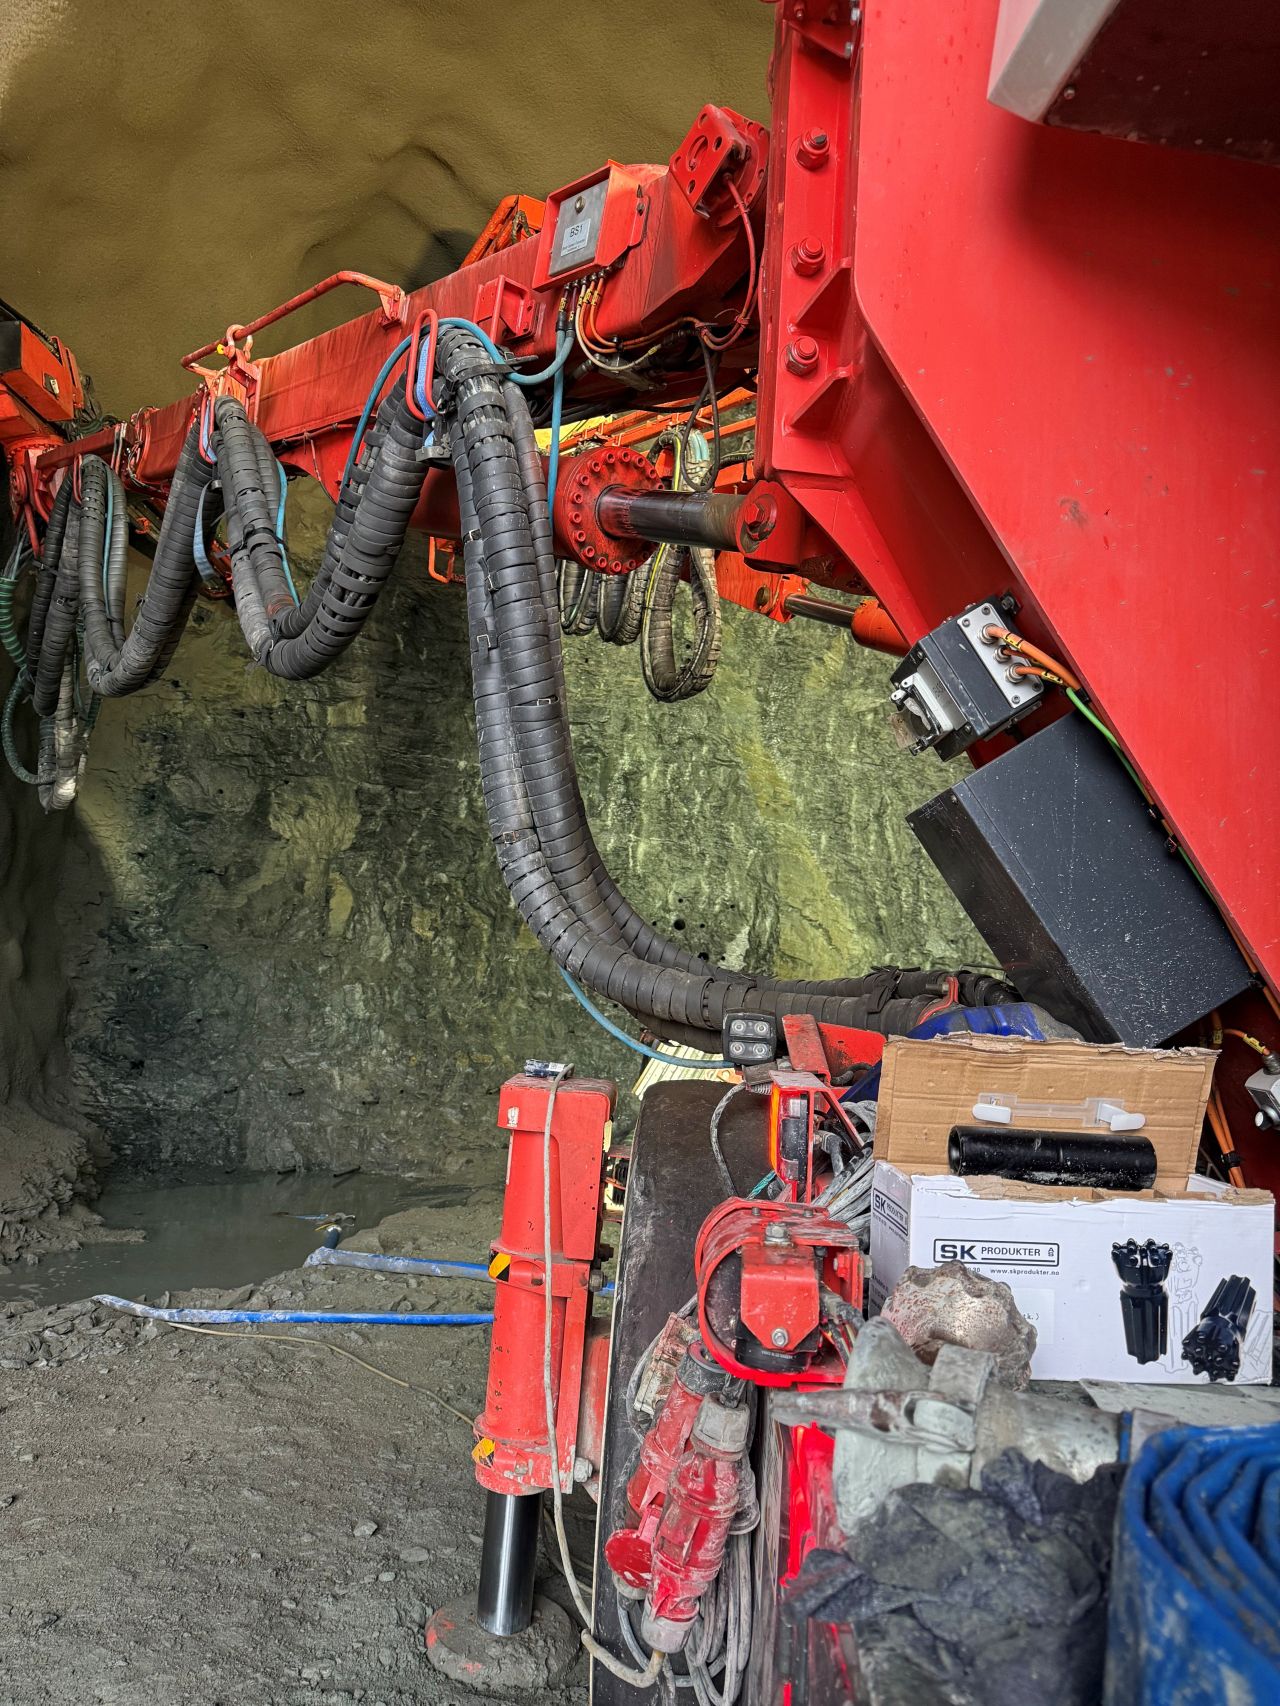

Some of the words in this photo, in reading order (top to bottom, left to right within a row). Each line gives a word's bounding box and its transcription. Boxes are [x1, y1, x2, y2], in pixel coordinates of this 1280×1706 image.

[570, 224, 583, 238] BS1
[874, 1194, 886, 1214] SK
[940, 1244, 977, 1260] SK
[981, 1246, 1041, 1257] PRODUKTER
[990, 1268, 1060, 1276] www.skprodukter.no
